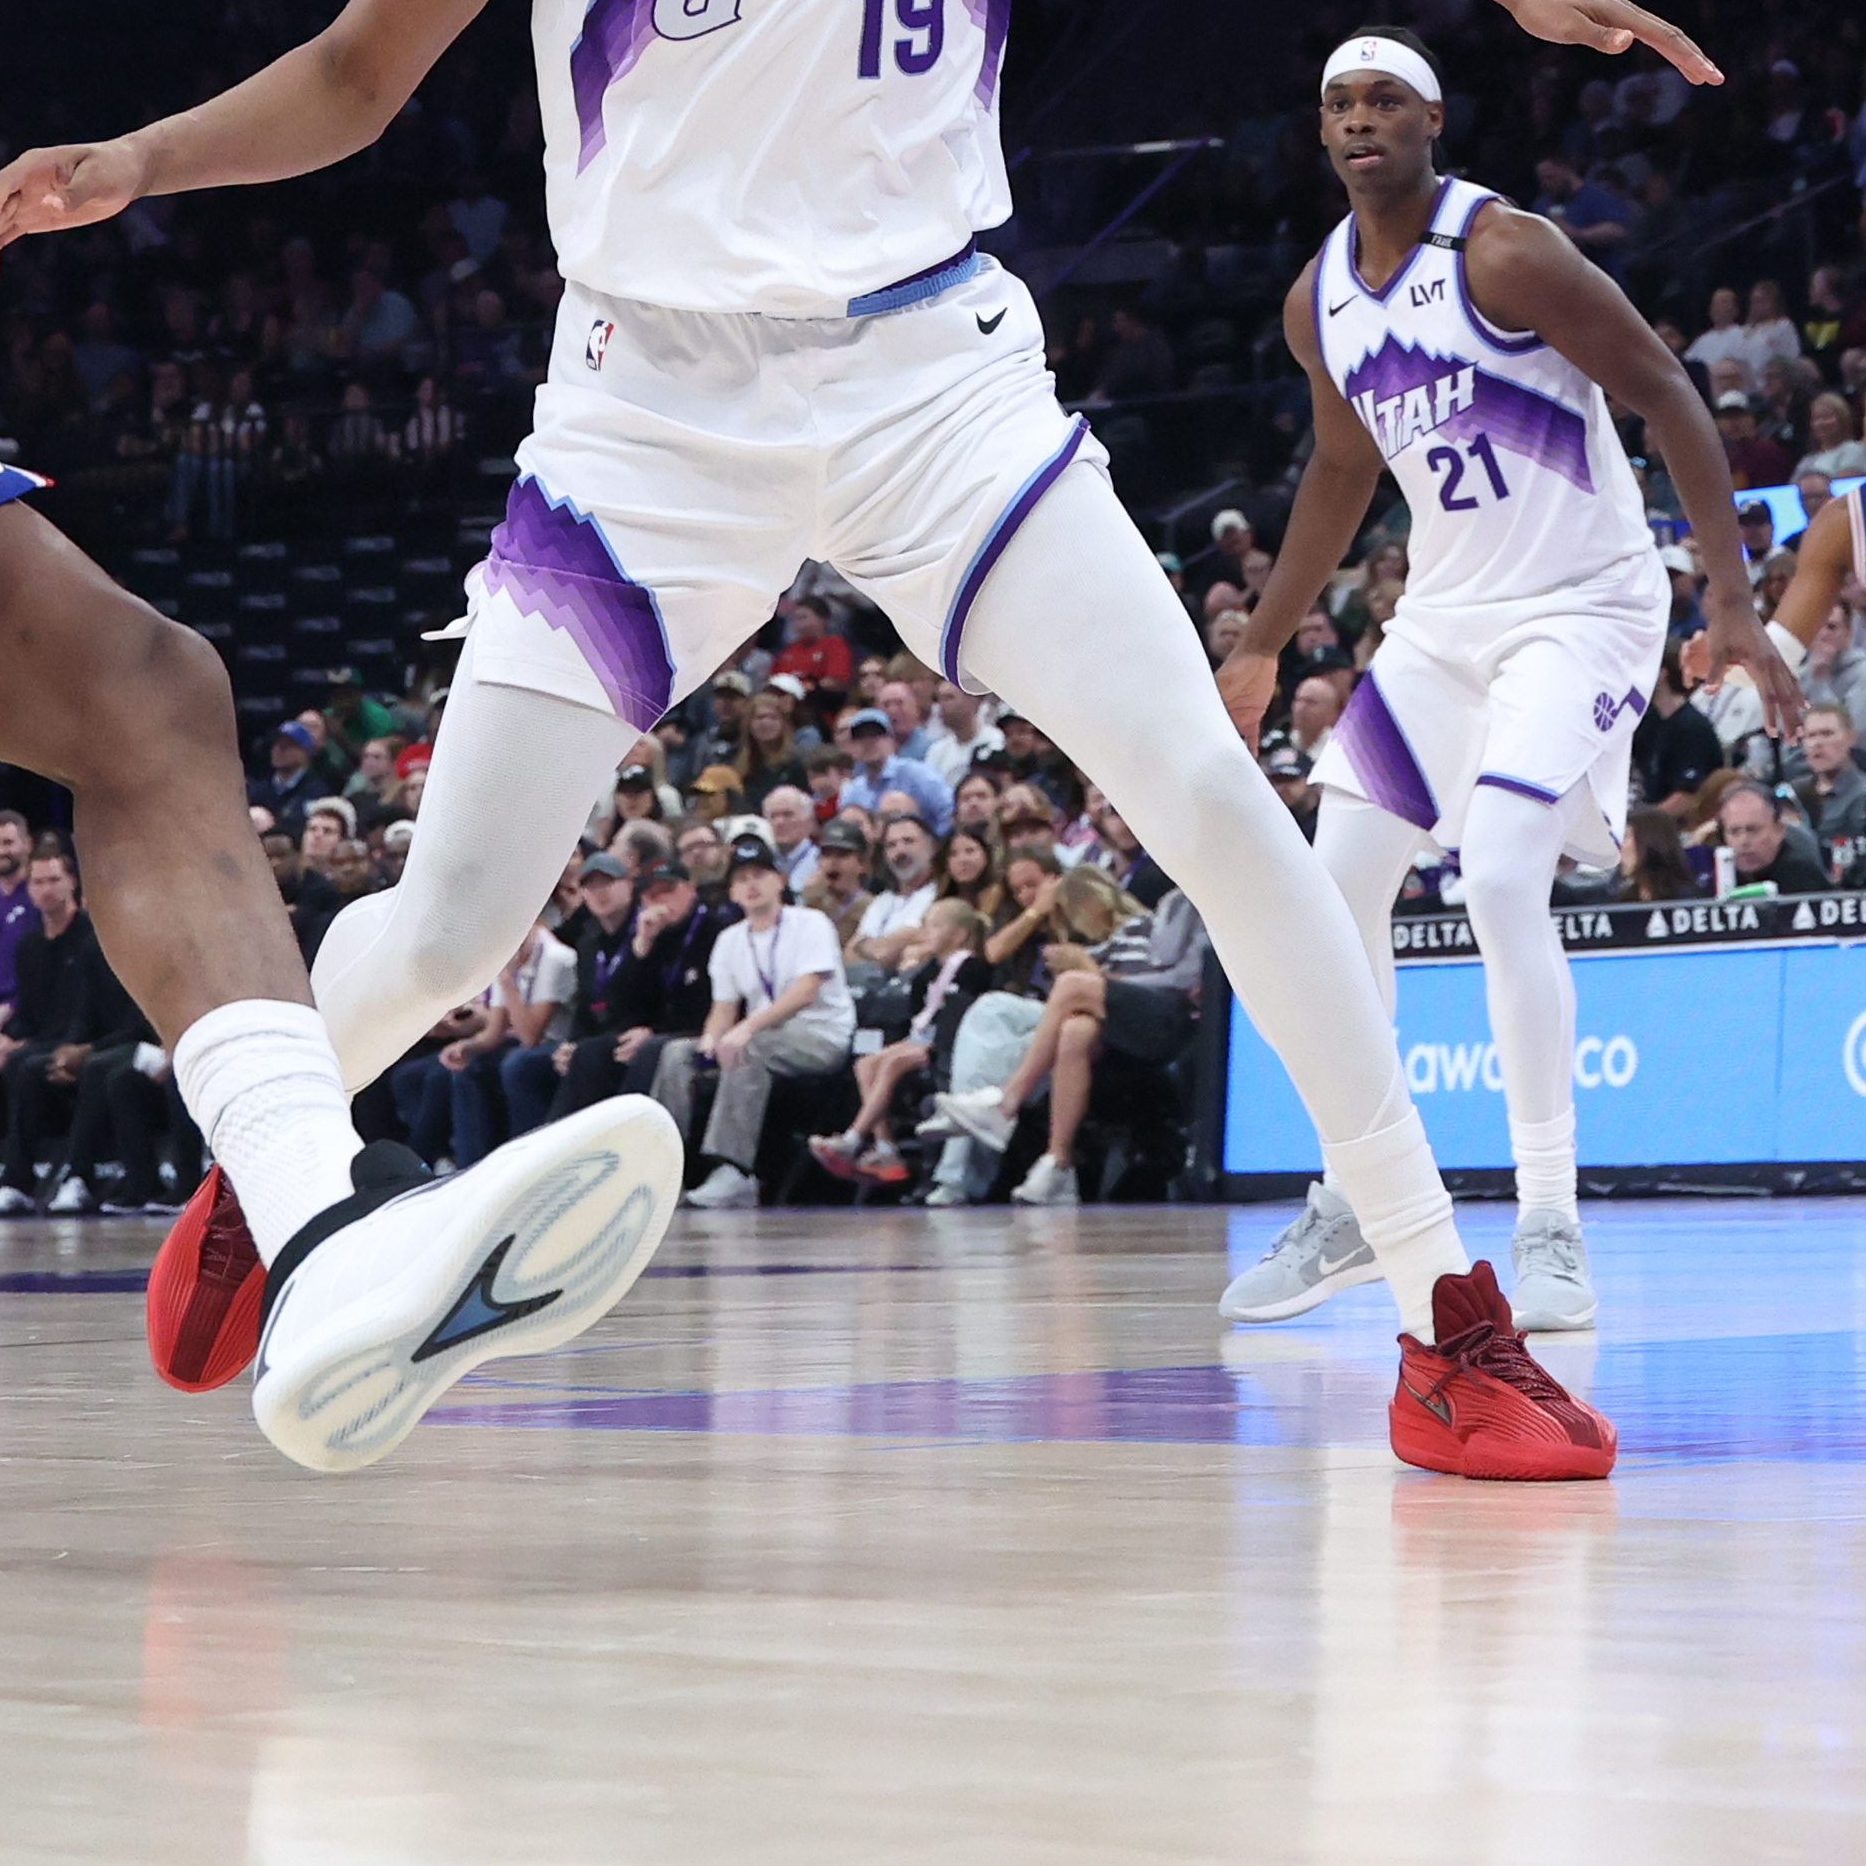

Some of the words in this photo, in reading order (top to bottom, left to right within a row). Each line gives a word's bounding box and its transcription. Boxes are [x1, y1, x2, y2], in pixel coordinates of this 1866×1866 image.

[1410, 278, 1446, 308] LVT
[1426, 433, 1510, 512] 21
[1553, 912, 1614, 941] ELTA
[1672, 905, 1759, 934] DELTA
